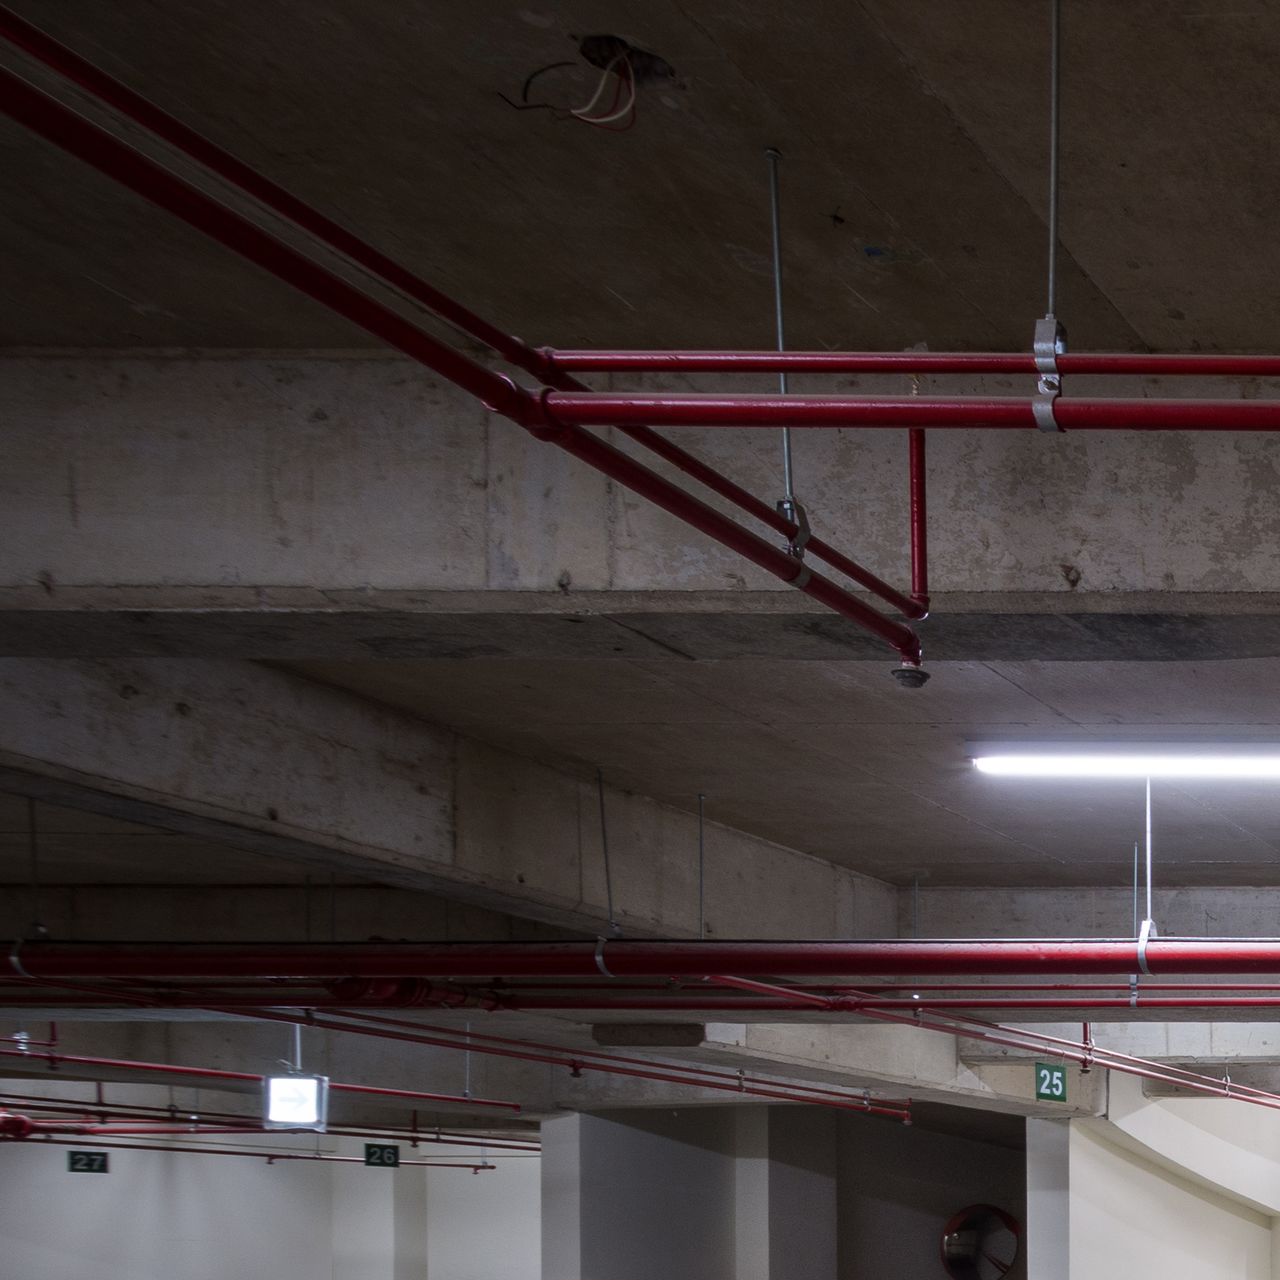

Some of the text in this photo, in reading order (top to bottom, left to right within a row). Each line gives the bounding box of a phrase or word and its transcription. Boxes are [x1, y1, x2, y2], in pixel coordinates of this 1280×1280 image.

[1040, 1069, 1063, 1096] 25
[73, 1154, 104, 1170] 27
[369, 1147, 395, 1164] 26
